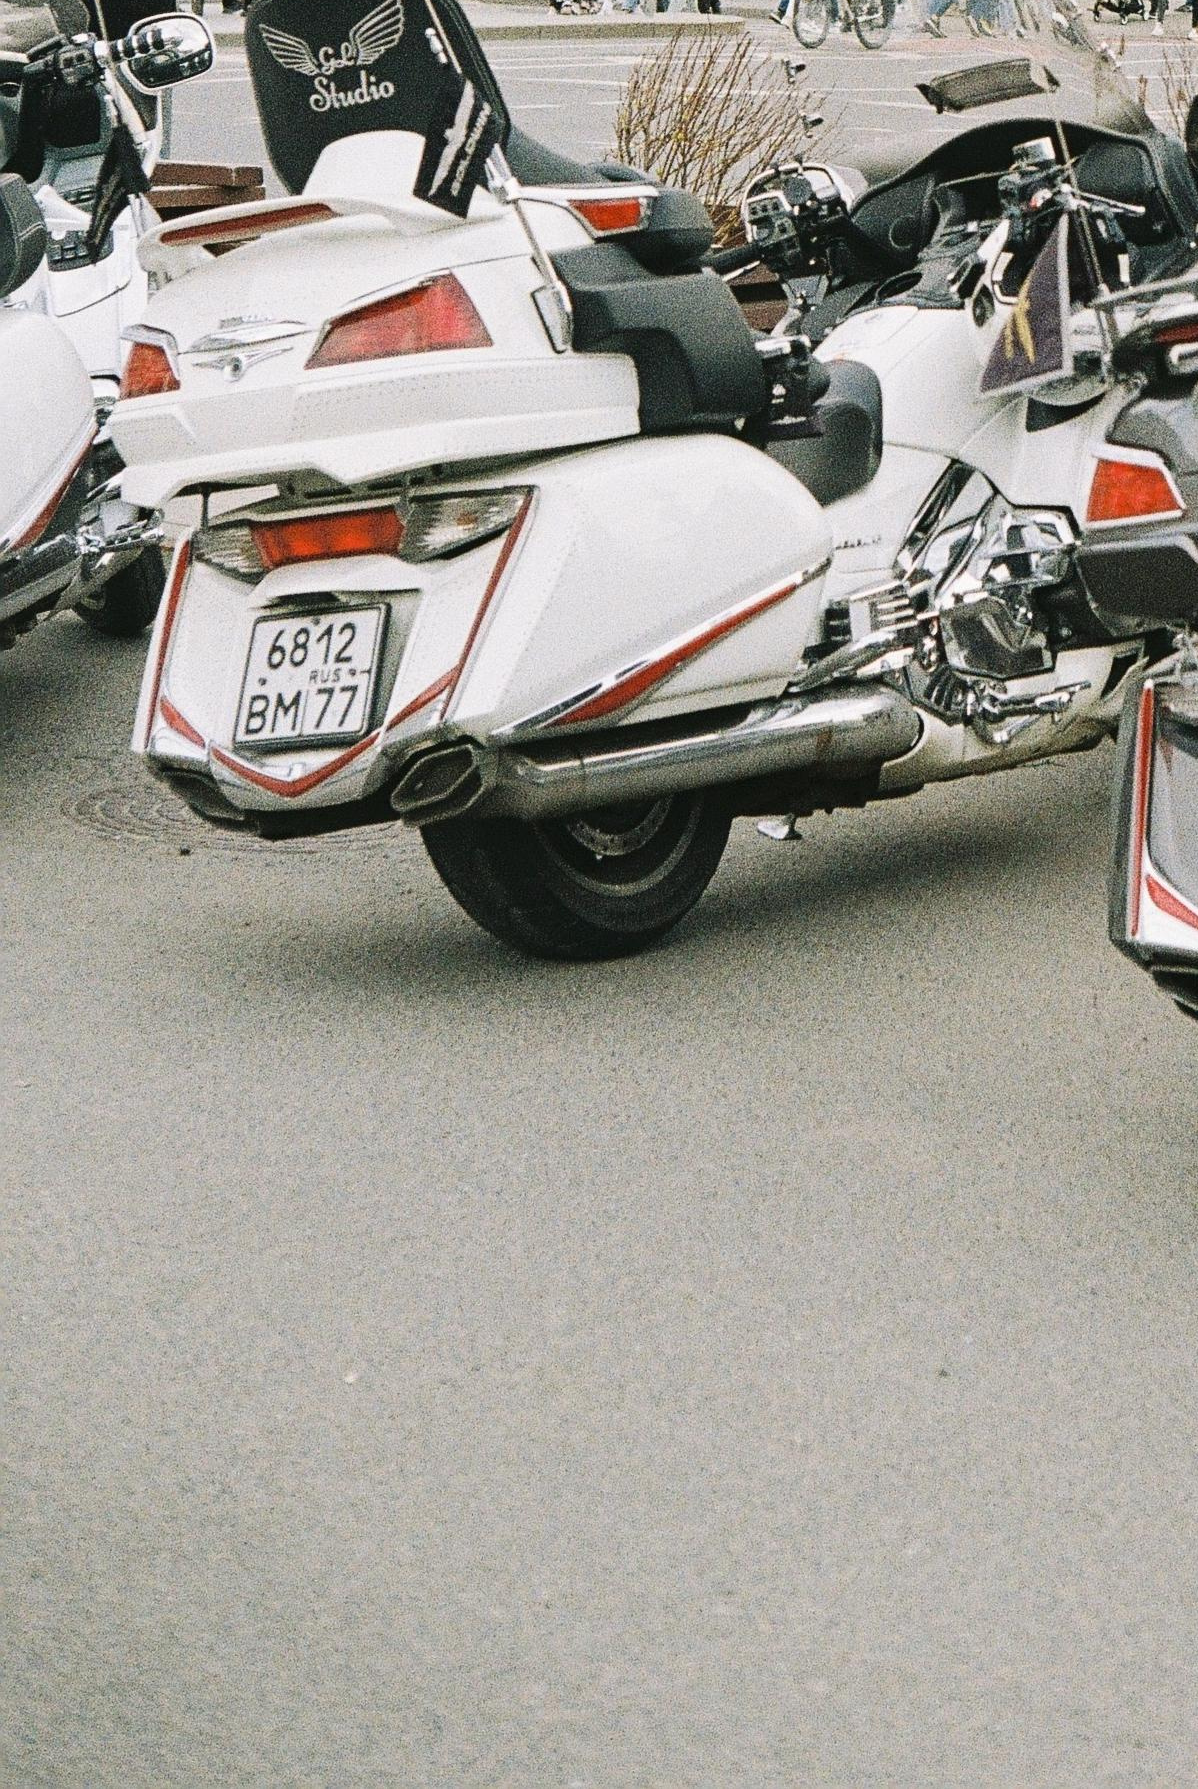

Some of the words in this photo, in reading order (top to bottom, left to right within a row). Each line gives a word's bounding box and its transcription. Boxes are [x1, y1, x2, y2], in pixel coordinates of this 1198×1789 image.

[309, 69, 395, 112] Studio
[267, 622, 357, 670] 6812
[309, 668, 342, 684] RUS
[316, 685, 359, 729] 77
